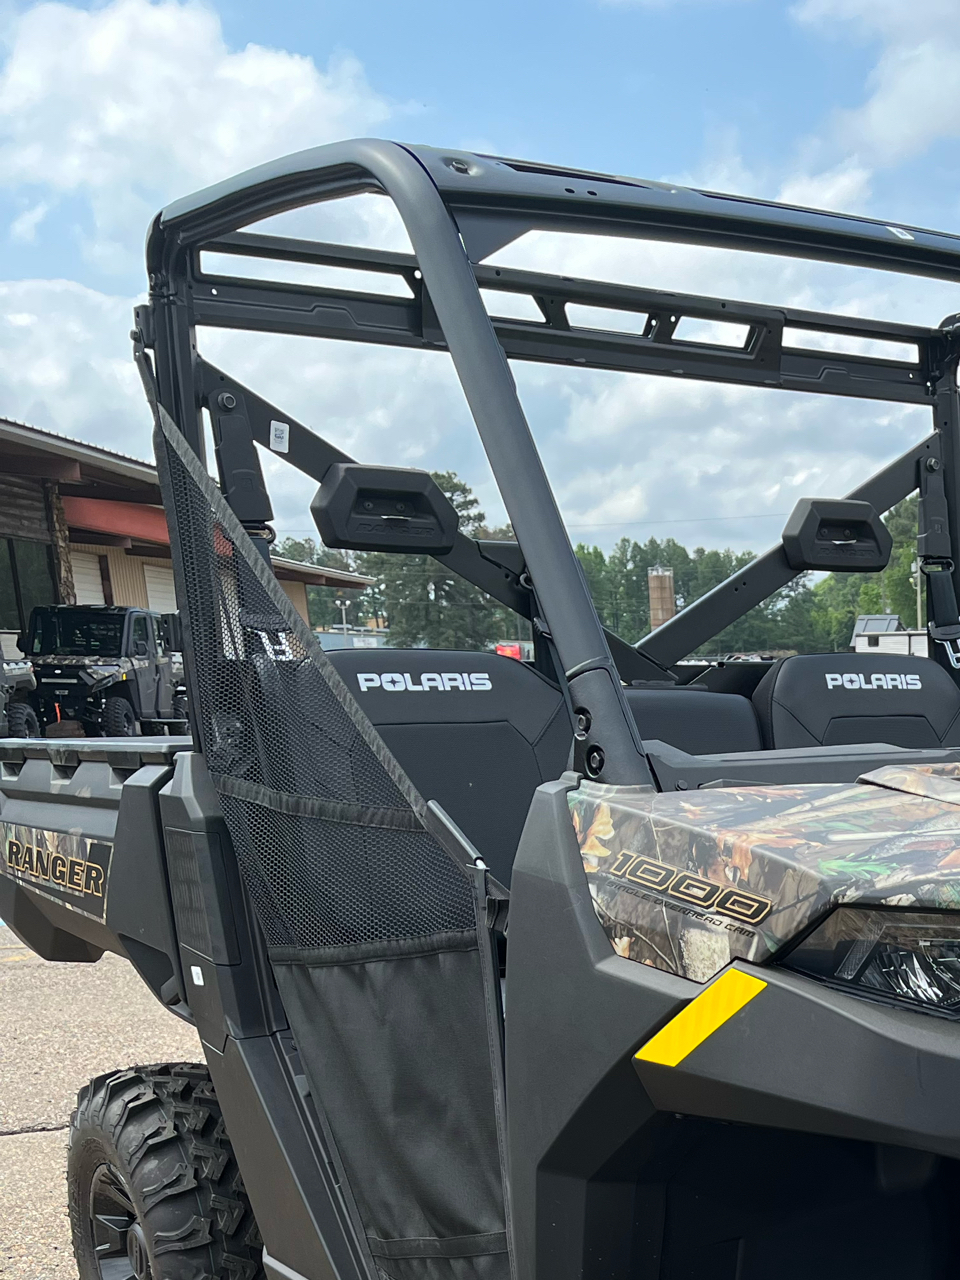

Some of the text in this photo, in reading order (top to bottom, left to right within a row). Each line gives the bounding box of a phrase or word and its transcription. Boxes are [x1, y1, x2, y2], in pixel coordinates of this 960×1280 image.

[356, 673, 493, 692] POLARIS
[825, 673, 922, 689] POLARIS
[7, 839, 105, 897] RANGER
[610, 850, 774, 927] 1000
[606, 880, 756, 938] SINGLE OVERHEAD CAM
